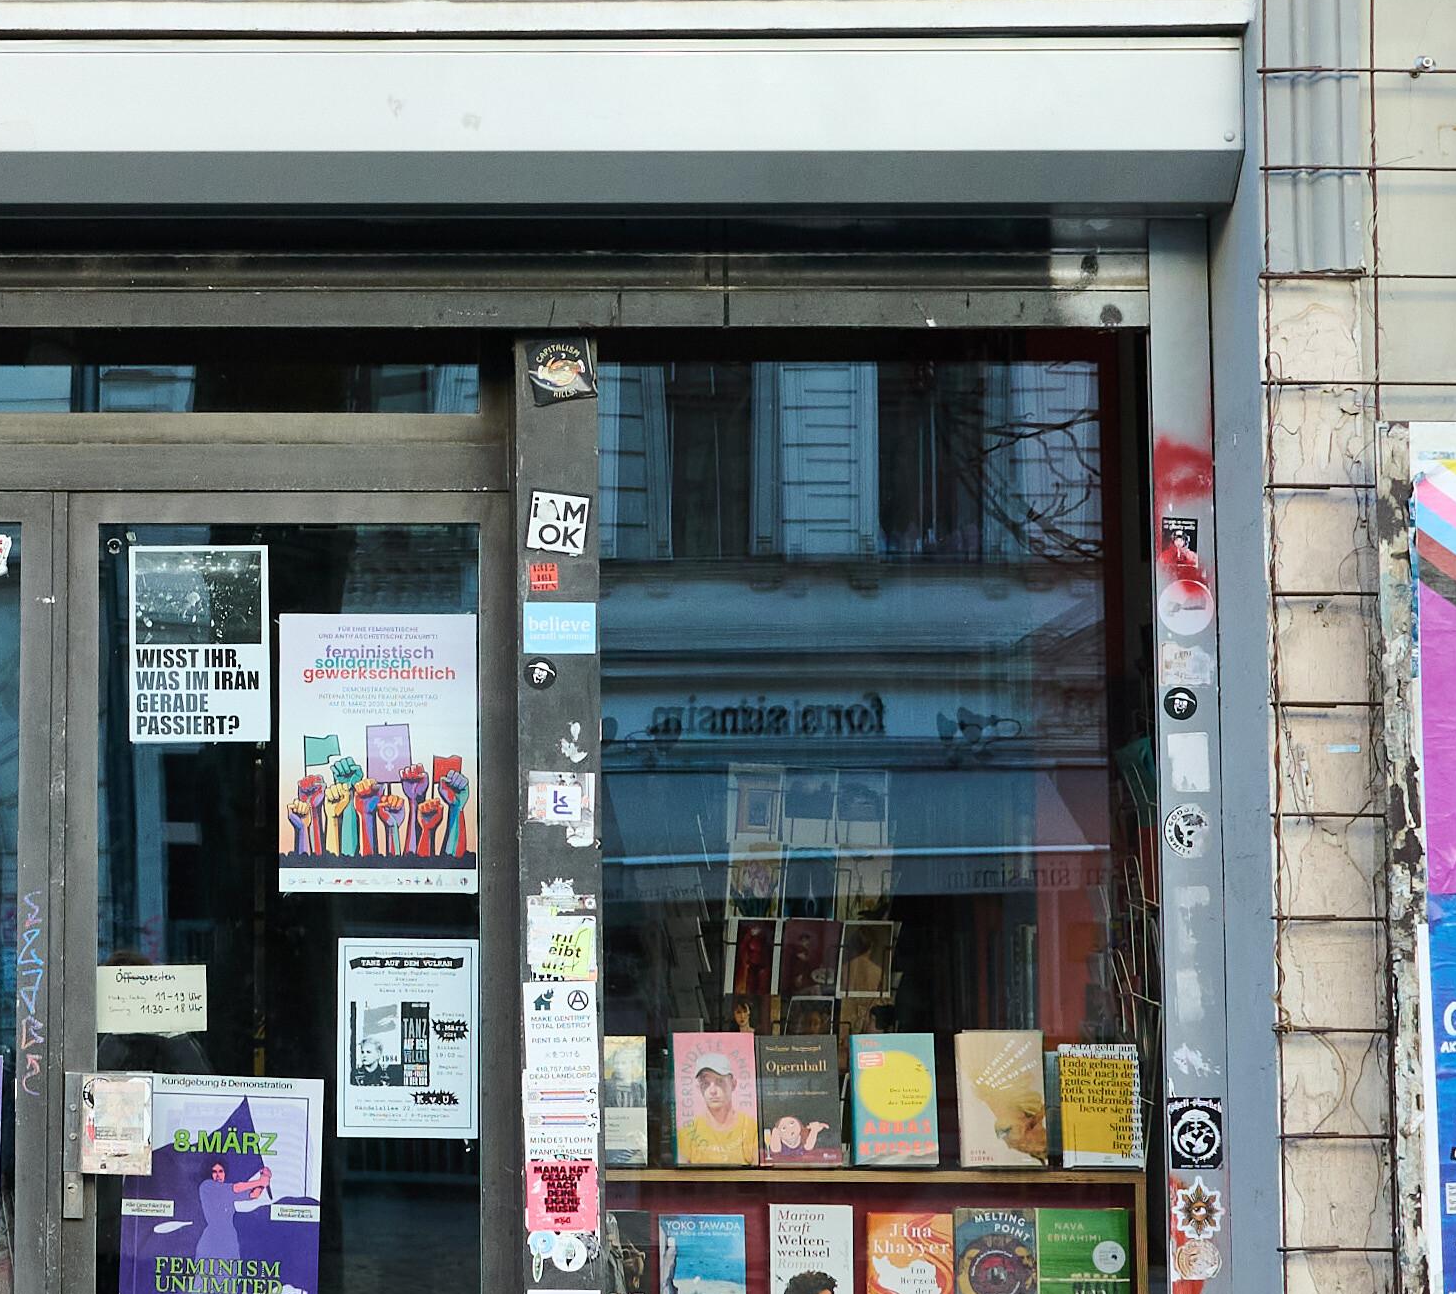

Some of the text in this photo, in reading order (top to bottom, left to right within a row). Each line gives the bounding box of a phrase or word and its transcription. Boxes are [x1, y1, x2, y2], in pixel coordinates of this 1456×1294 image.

[538, 523, 580, 549] OK
[136, 649, 241, 670] WISST IHR,
[325, 644, 434, 660] feministisch
[315, 655, 411, 669] solidarisch
[136, 671, 260, 691] WAS IM IRAN
[303, 665, 456, 683] gewerkschaftlich
[136, 694, 208, 713] GERADE
[136, 715, 240, 735] PASSIERT?
[766, 1058, 827, 1076] Opernball
[665, 1220, 740, 1232] YOKO TAWADA
